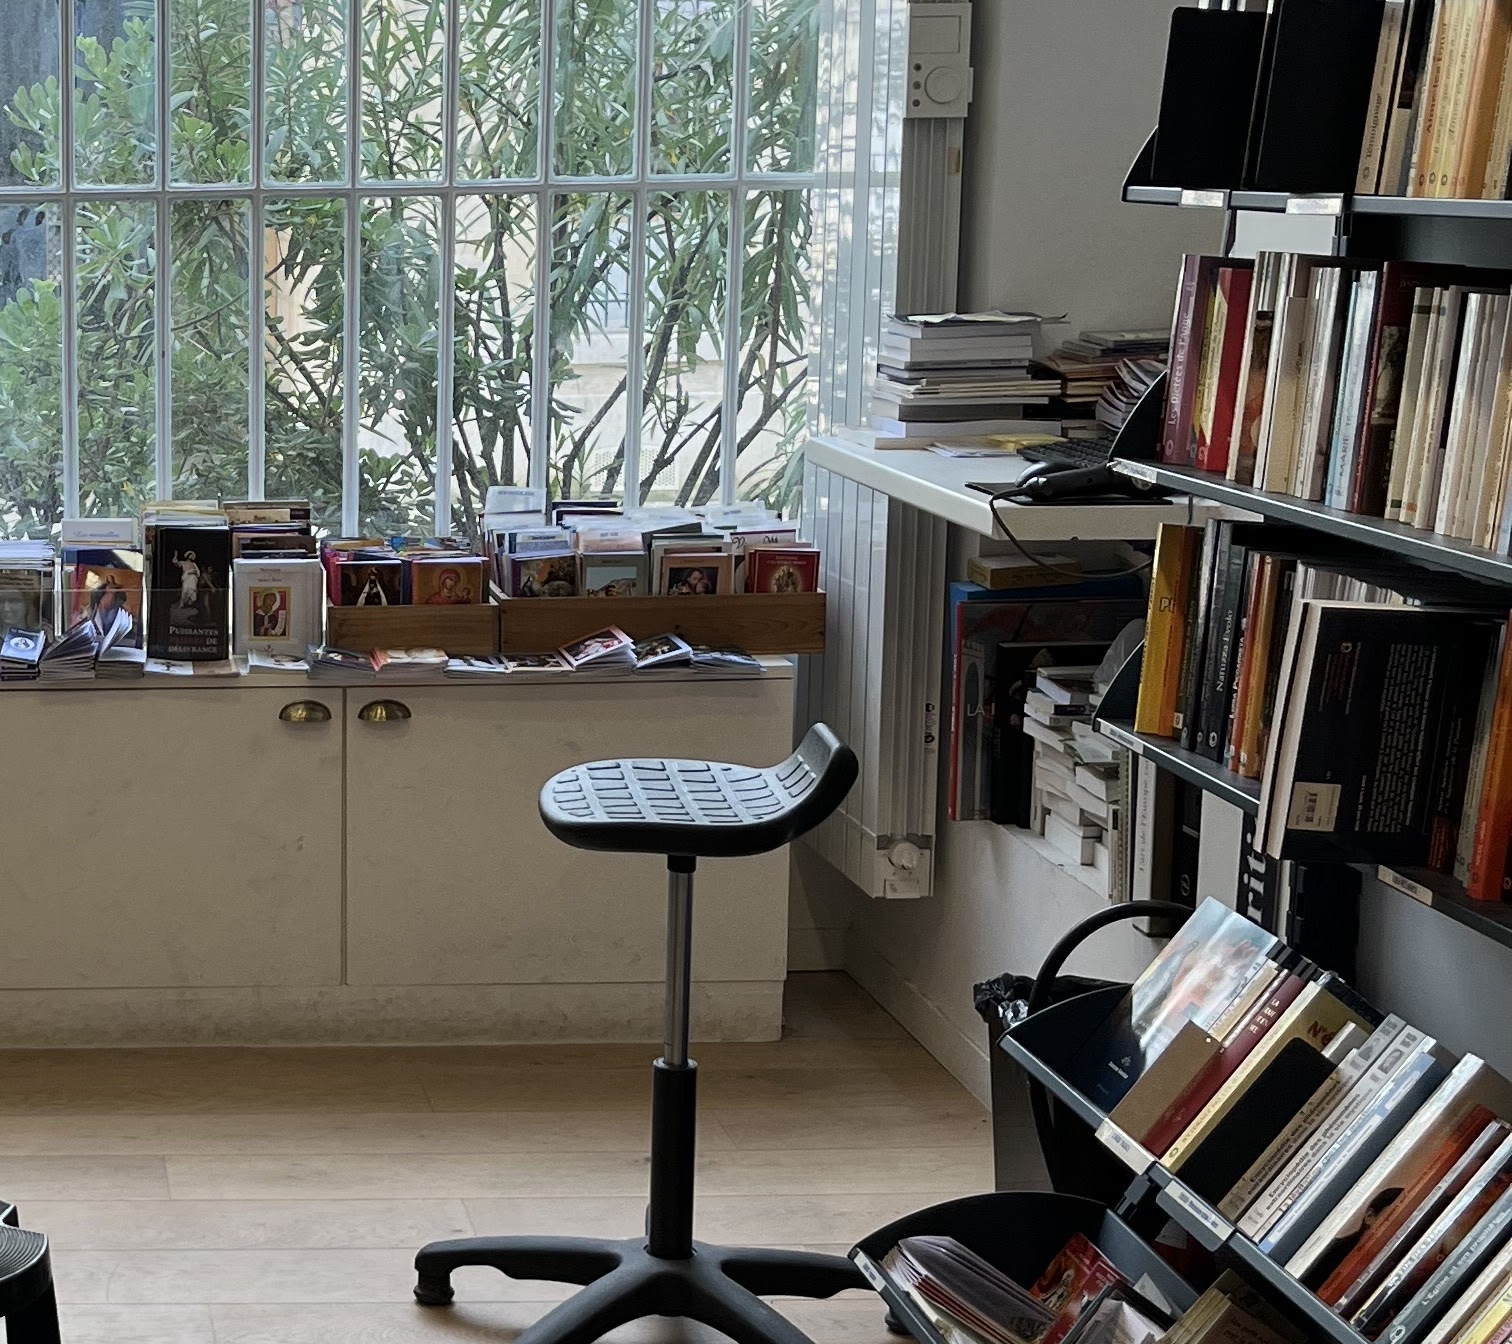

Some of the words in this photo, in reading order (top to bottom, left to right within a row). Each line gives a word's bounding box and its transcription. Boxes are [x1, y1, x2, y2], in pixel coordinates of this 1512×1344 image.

[1171, 372, 1184, 409] Dictées
[1168, 412, 1177, 425] Les
[169, 626, 219, 636] PUISSANTES
[1222, 610, 1234, 641] Evolo
[1216, 648, 1229, 692] Natuzza
[967, 704, 985, 717] LA
